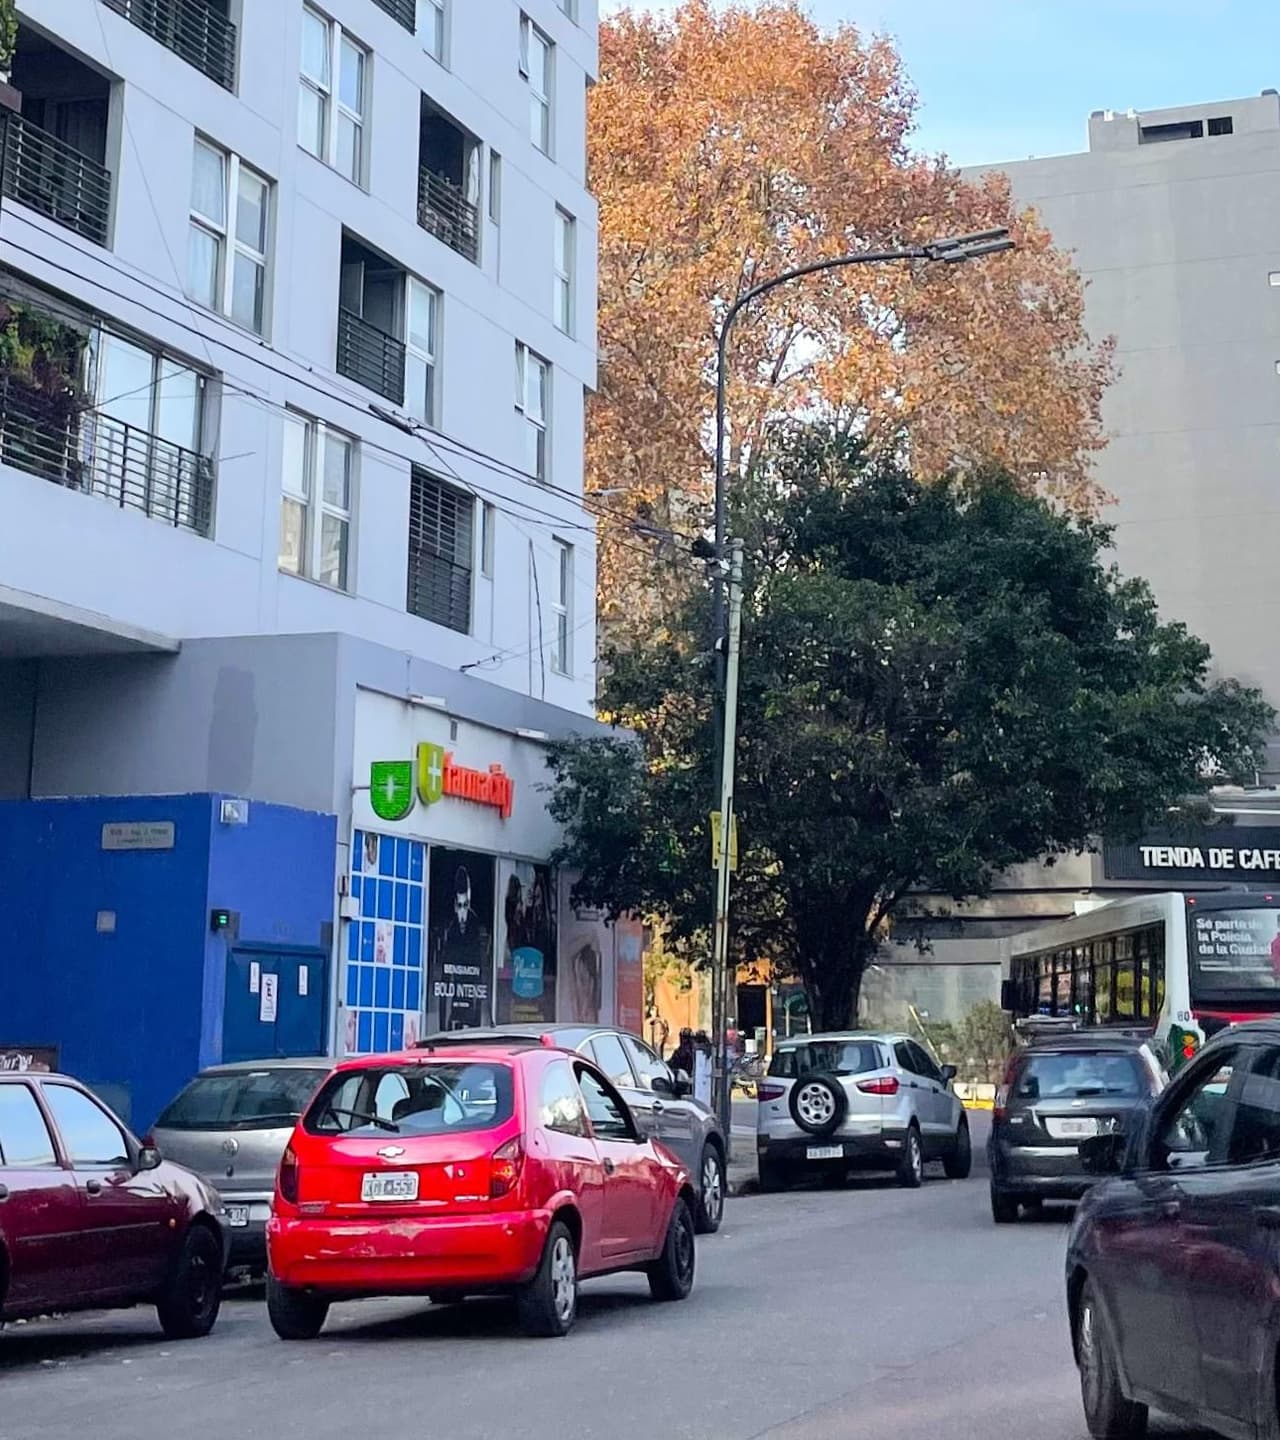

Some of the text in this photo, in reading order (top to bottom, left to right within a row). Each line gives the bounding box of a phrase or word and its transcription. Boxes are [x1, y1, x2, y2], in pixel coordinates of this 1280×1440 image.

[1139, 846, 1205, 868] TIENDA
[1209, 848, 1235, 869] DE
[434, 982, 488, 998] BOLD INTENSE
